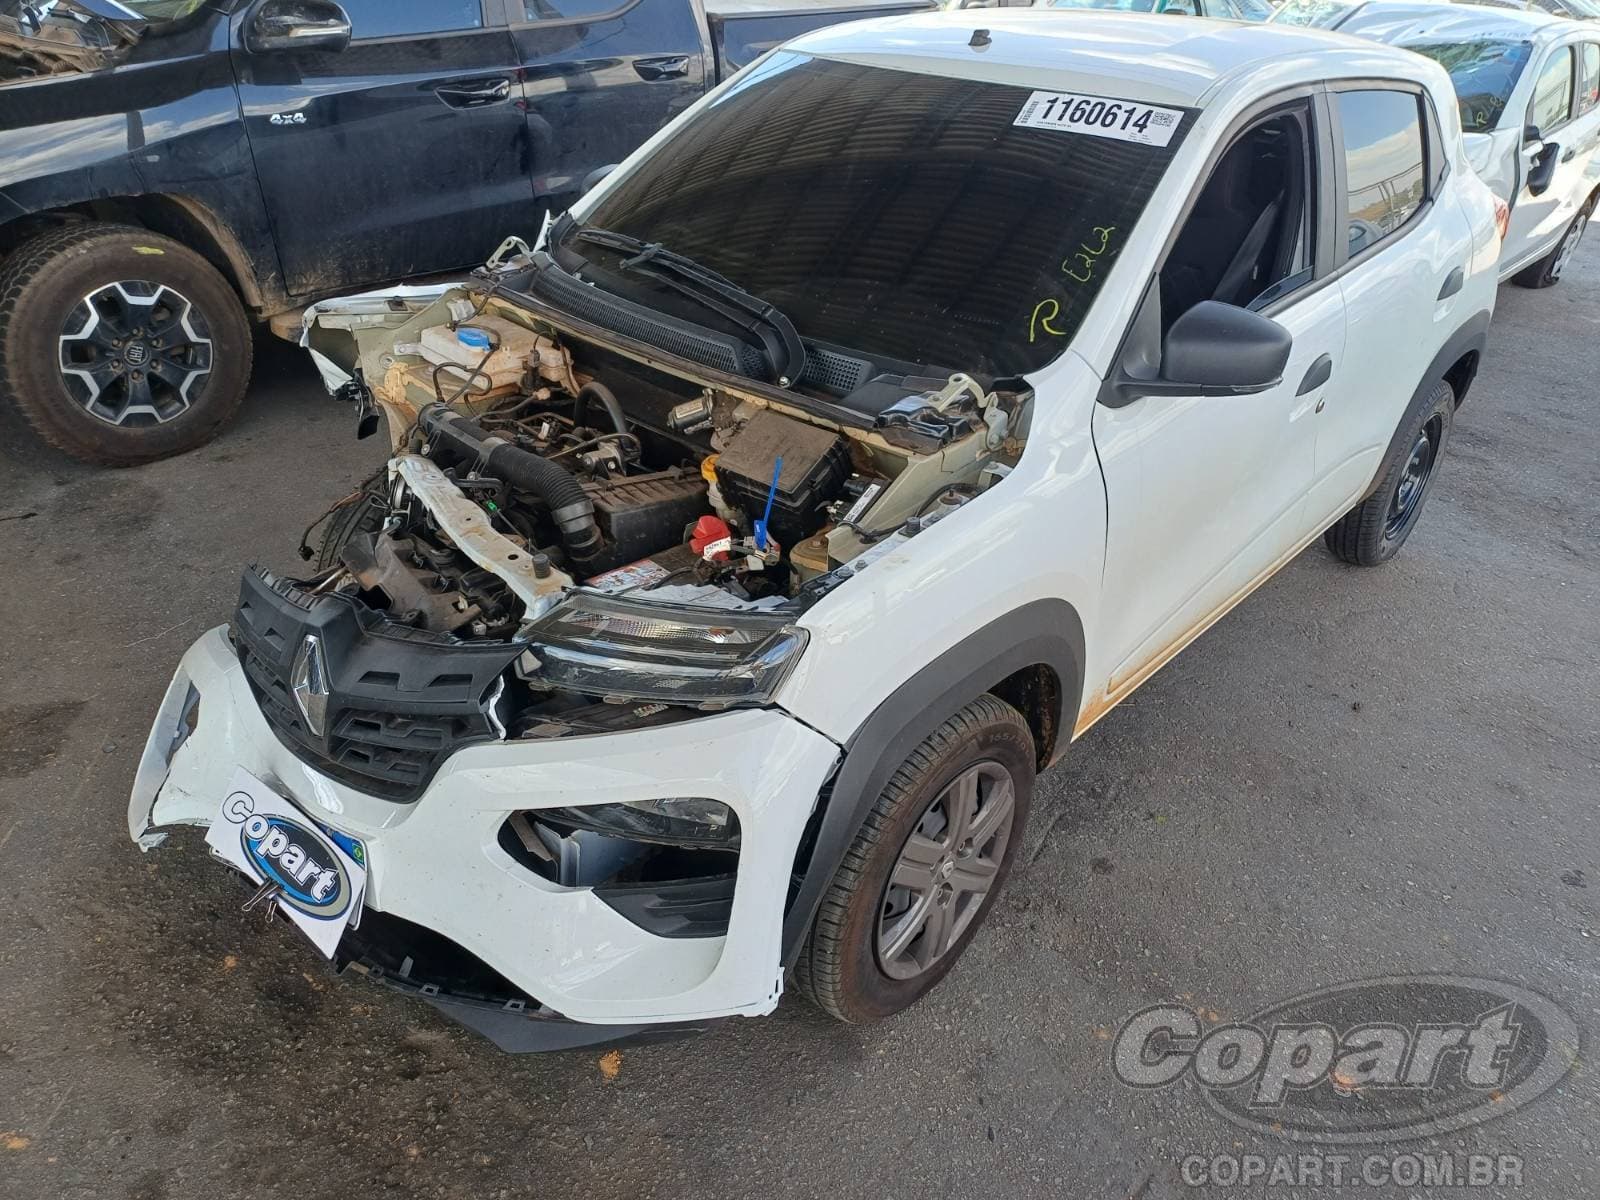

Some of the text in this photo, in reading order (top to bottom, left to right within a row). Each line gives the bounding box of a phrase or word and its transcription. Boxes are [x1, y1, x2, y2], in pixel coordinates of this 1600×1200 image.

[1041, 97, 1154, 134] 1160614
[1029, 298, 1068, 342] R
[222, 791, 339, 903] Copart
